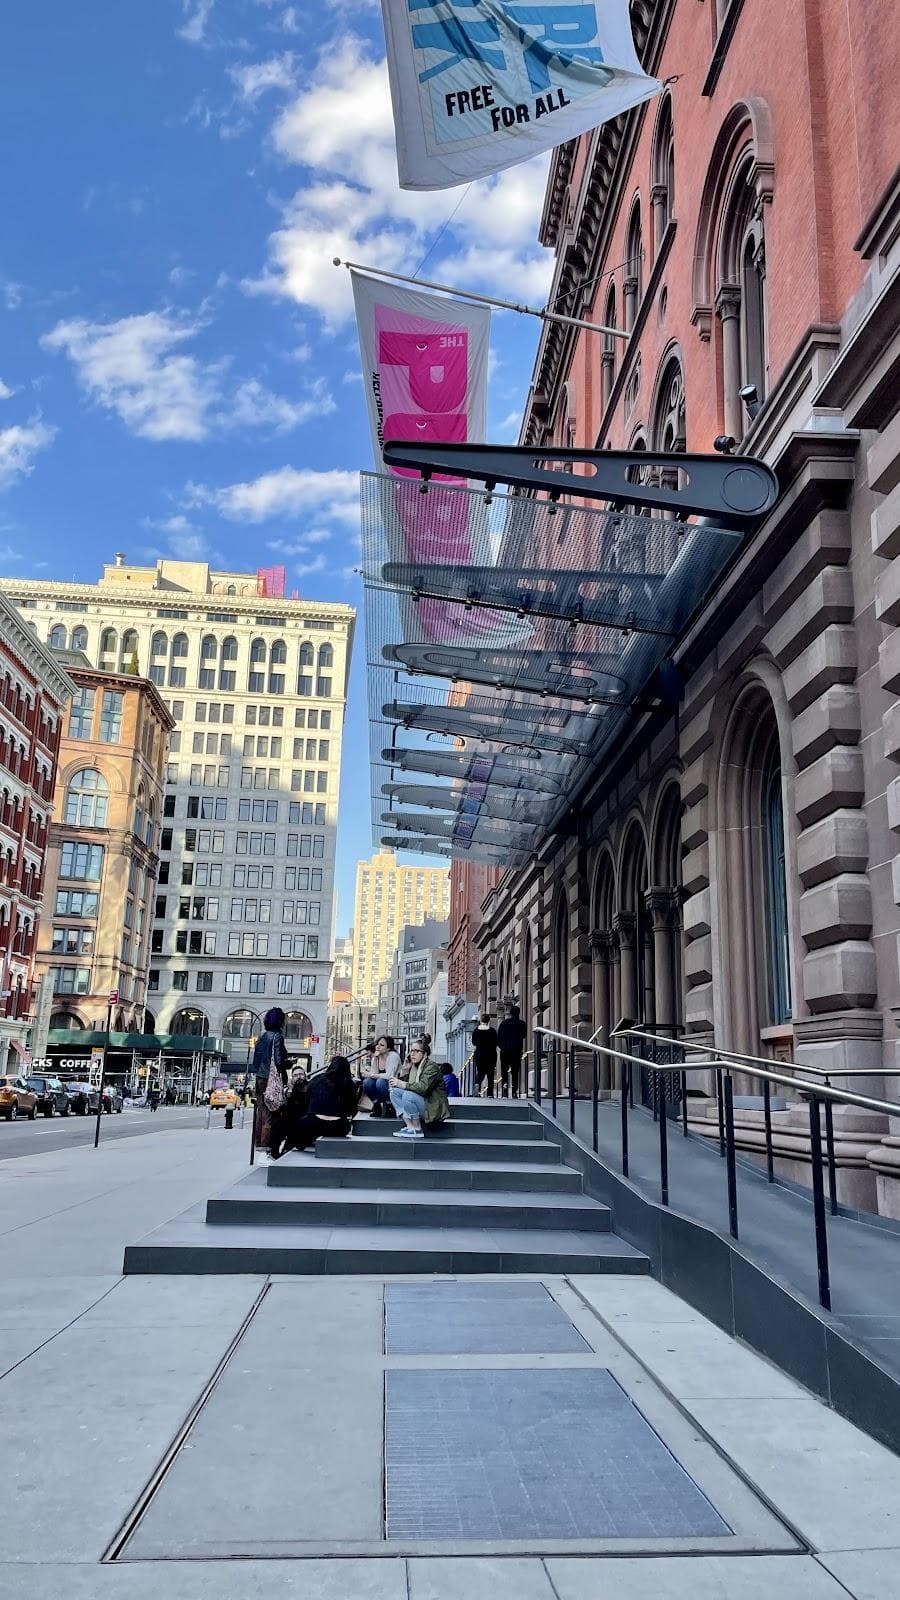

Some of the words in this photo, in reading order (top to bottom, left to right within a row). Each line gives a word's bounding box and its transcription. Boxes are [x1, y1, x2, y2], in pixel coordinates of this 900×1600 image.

[445, 85, 495, 117] FREE
[490, 104, 531, 132] FOR
[535, 88, 571, 120] ALL
[439, 335, 465, 348] THE
[59, 1059, 98, 1069] COFFE
